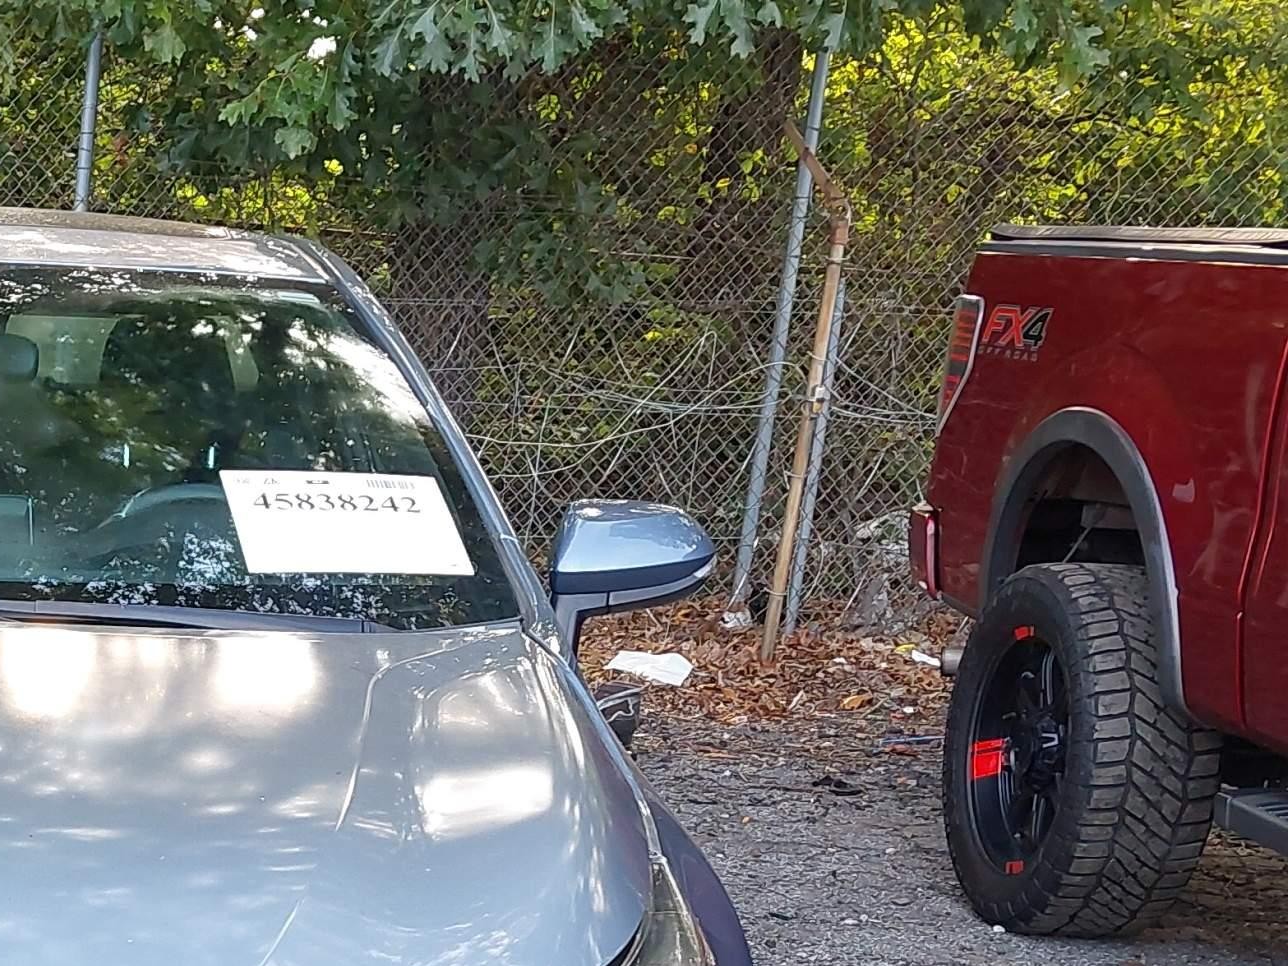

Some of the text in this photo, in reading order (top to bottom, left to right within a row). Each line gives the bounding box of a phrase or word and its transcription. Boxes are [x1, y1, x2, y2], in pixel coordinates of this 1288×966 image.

[981, 303, 1055, 351] FX4
[977, 345, 1039, 362] OFF ROAD
[253, 491, 421, 514] 45838242
